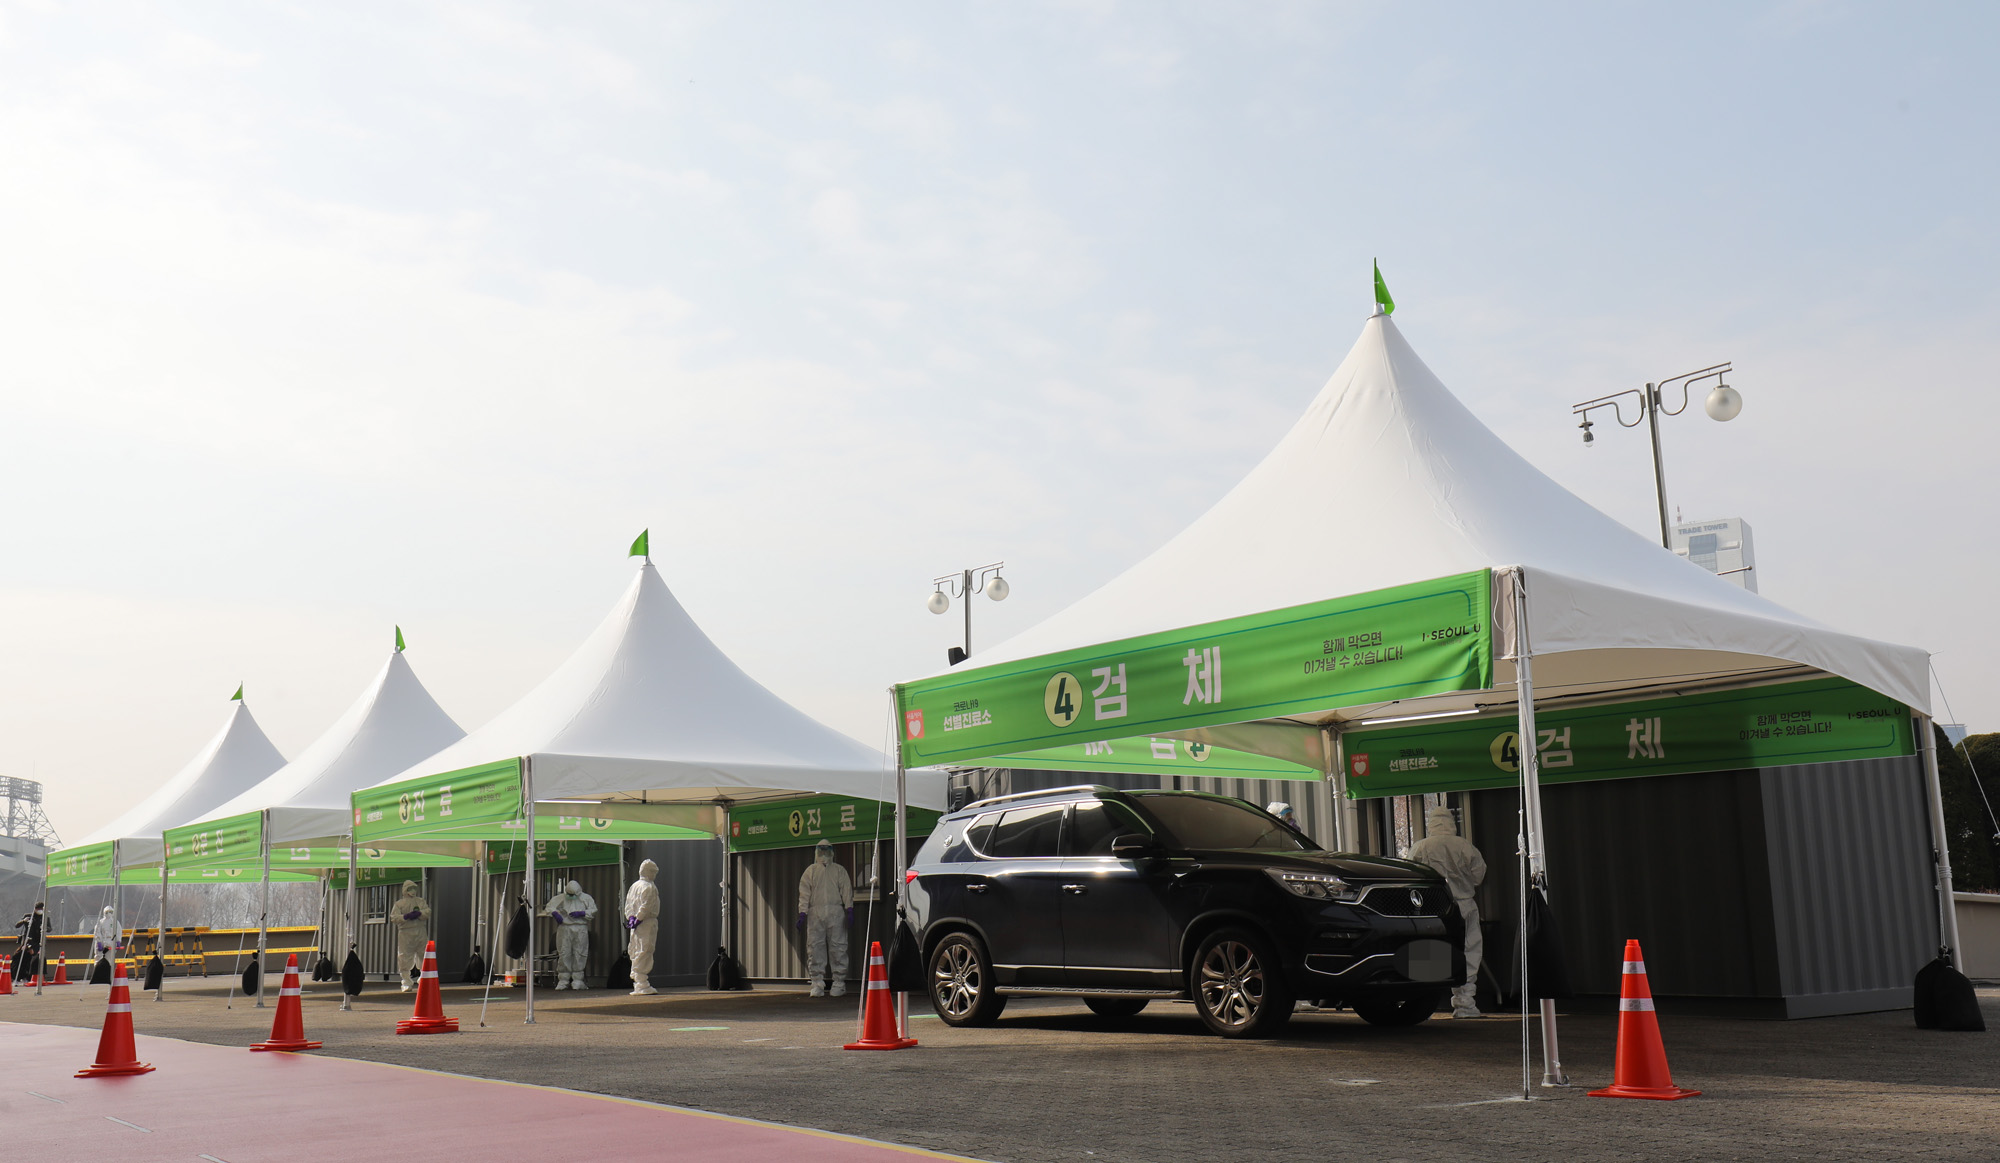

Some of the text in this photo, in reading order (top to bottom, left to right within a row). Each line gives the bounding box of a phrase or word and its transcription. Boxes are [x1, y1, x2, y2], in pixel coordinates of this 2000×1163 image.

[1678, 523, 1728, 535] TRADE TOWER
[1323, 631, 1382, 655] 함께 막으면
[1304, 645, 1403, 675] 이겨낼 수 있습니다!
[1054, 677, 1074, 721] 4
[943, 709, 992, 732] 선별진료소
[1757, 710, 1812, 726] 함께 막으면
[1740, 721, 1832, 741] 이겨낼 수 있습니다!
[1500, 735, 1519, 768] 4
[1389, 756, 1439, 772] 선별진료소
